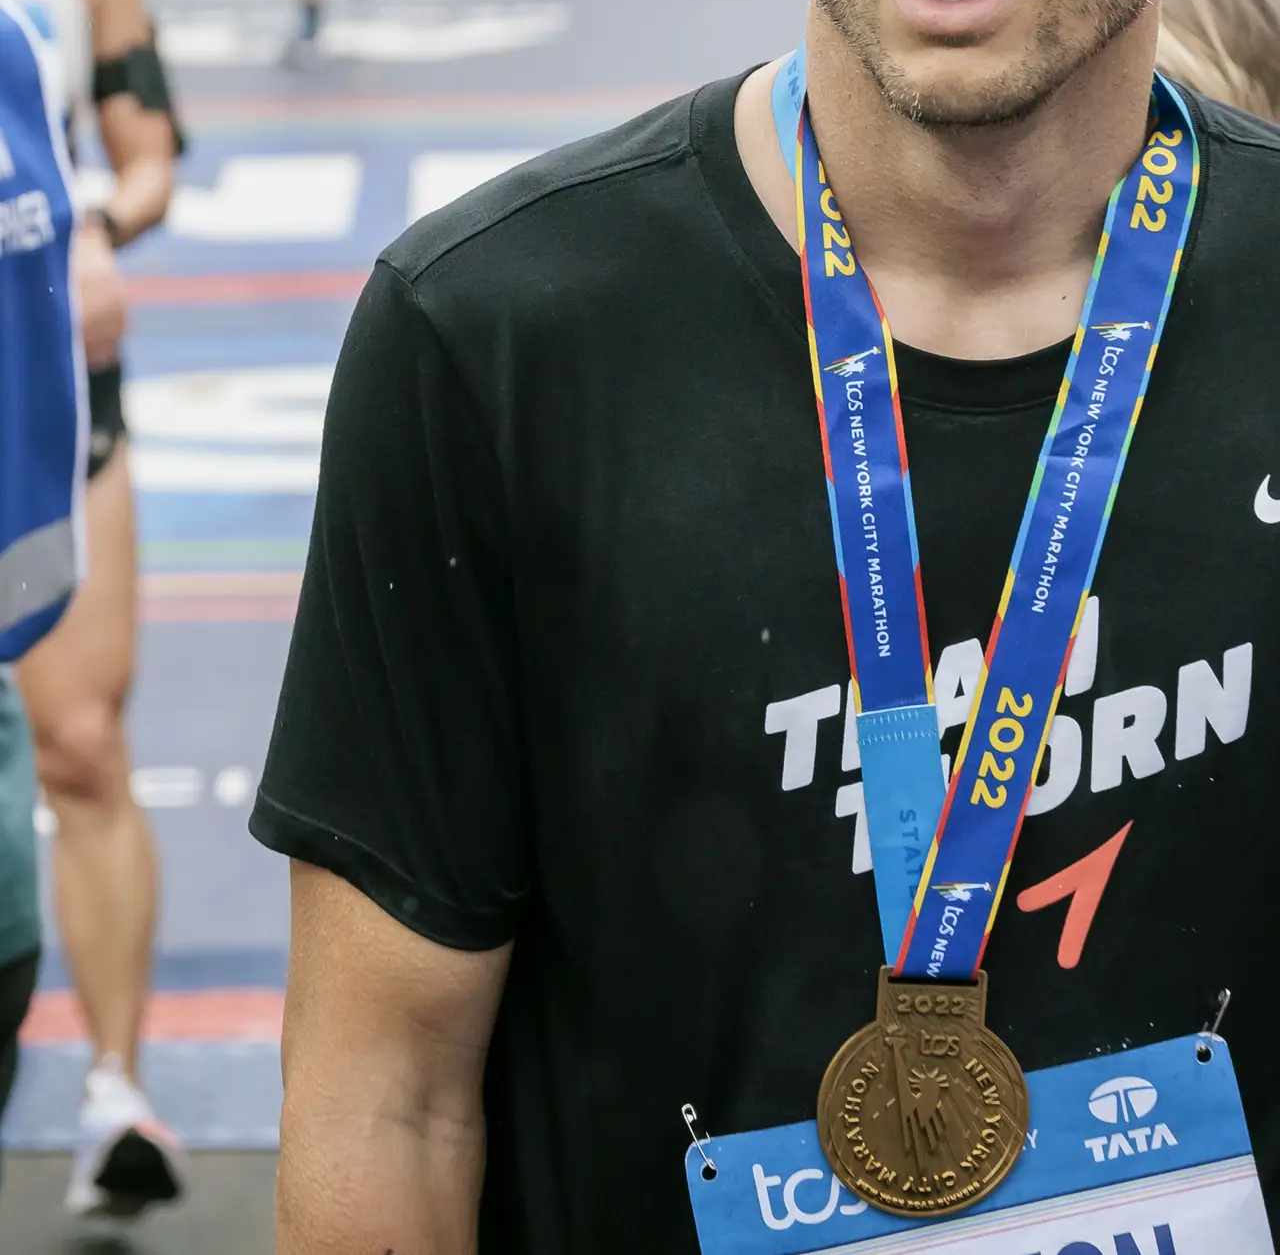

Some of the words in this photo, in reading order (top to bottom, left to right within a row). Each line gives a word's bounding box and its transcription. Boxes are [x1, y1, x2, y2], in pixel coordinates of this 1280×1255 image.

[1129, 129, 1183, 233] 2022
[818, 160, 856, 278] 022
[1099, 345, 1124, 377] tcs
[845, 380, 865, 412] tcs
[1087, 378, 1109, 421] NEW
[849, 415, 867, 457] NEW
[1069, 423, 1097, 469] YORK
[855, 460, 873, 509] YORK
[1059, 471, 1081, 513] CITY
[862, 511, 878, 553] CITY
[1031, 514, 1069, 614] MARATHON
[866, 557, 892, 658] MARATHON
[970, 686, 1033, 809] 2022
[939, 905, 964, 937] tcs
[926, 937, 948, 979] NEW
[897, 995, 966, 1015] 2022
[919, 1028, 960, 1057] tcs
[964, 1057, 1001, 1107] NEW
[843, 1061, 897, 1183] MARATHON
[959, 1113, 1002, 1171] YORK
[1084, 1122, 1179, 1163] TATA
[902, 1170, 957, 1192] CITY
